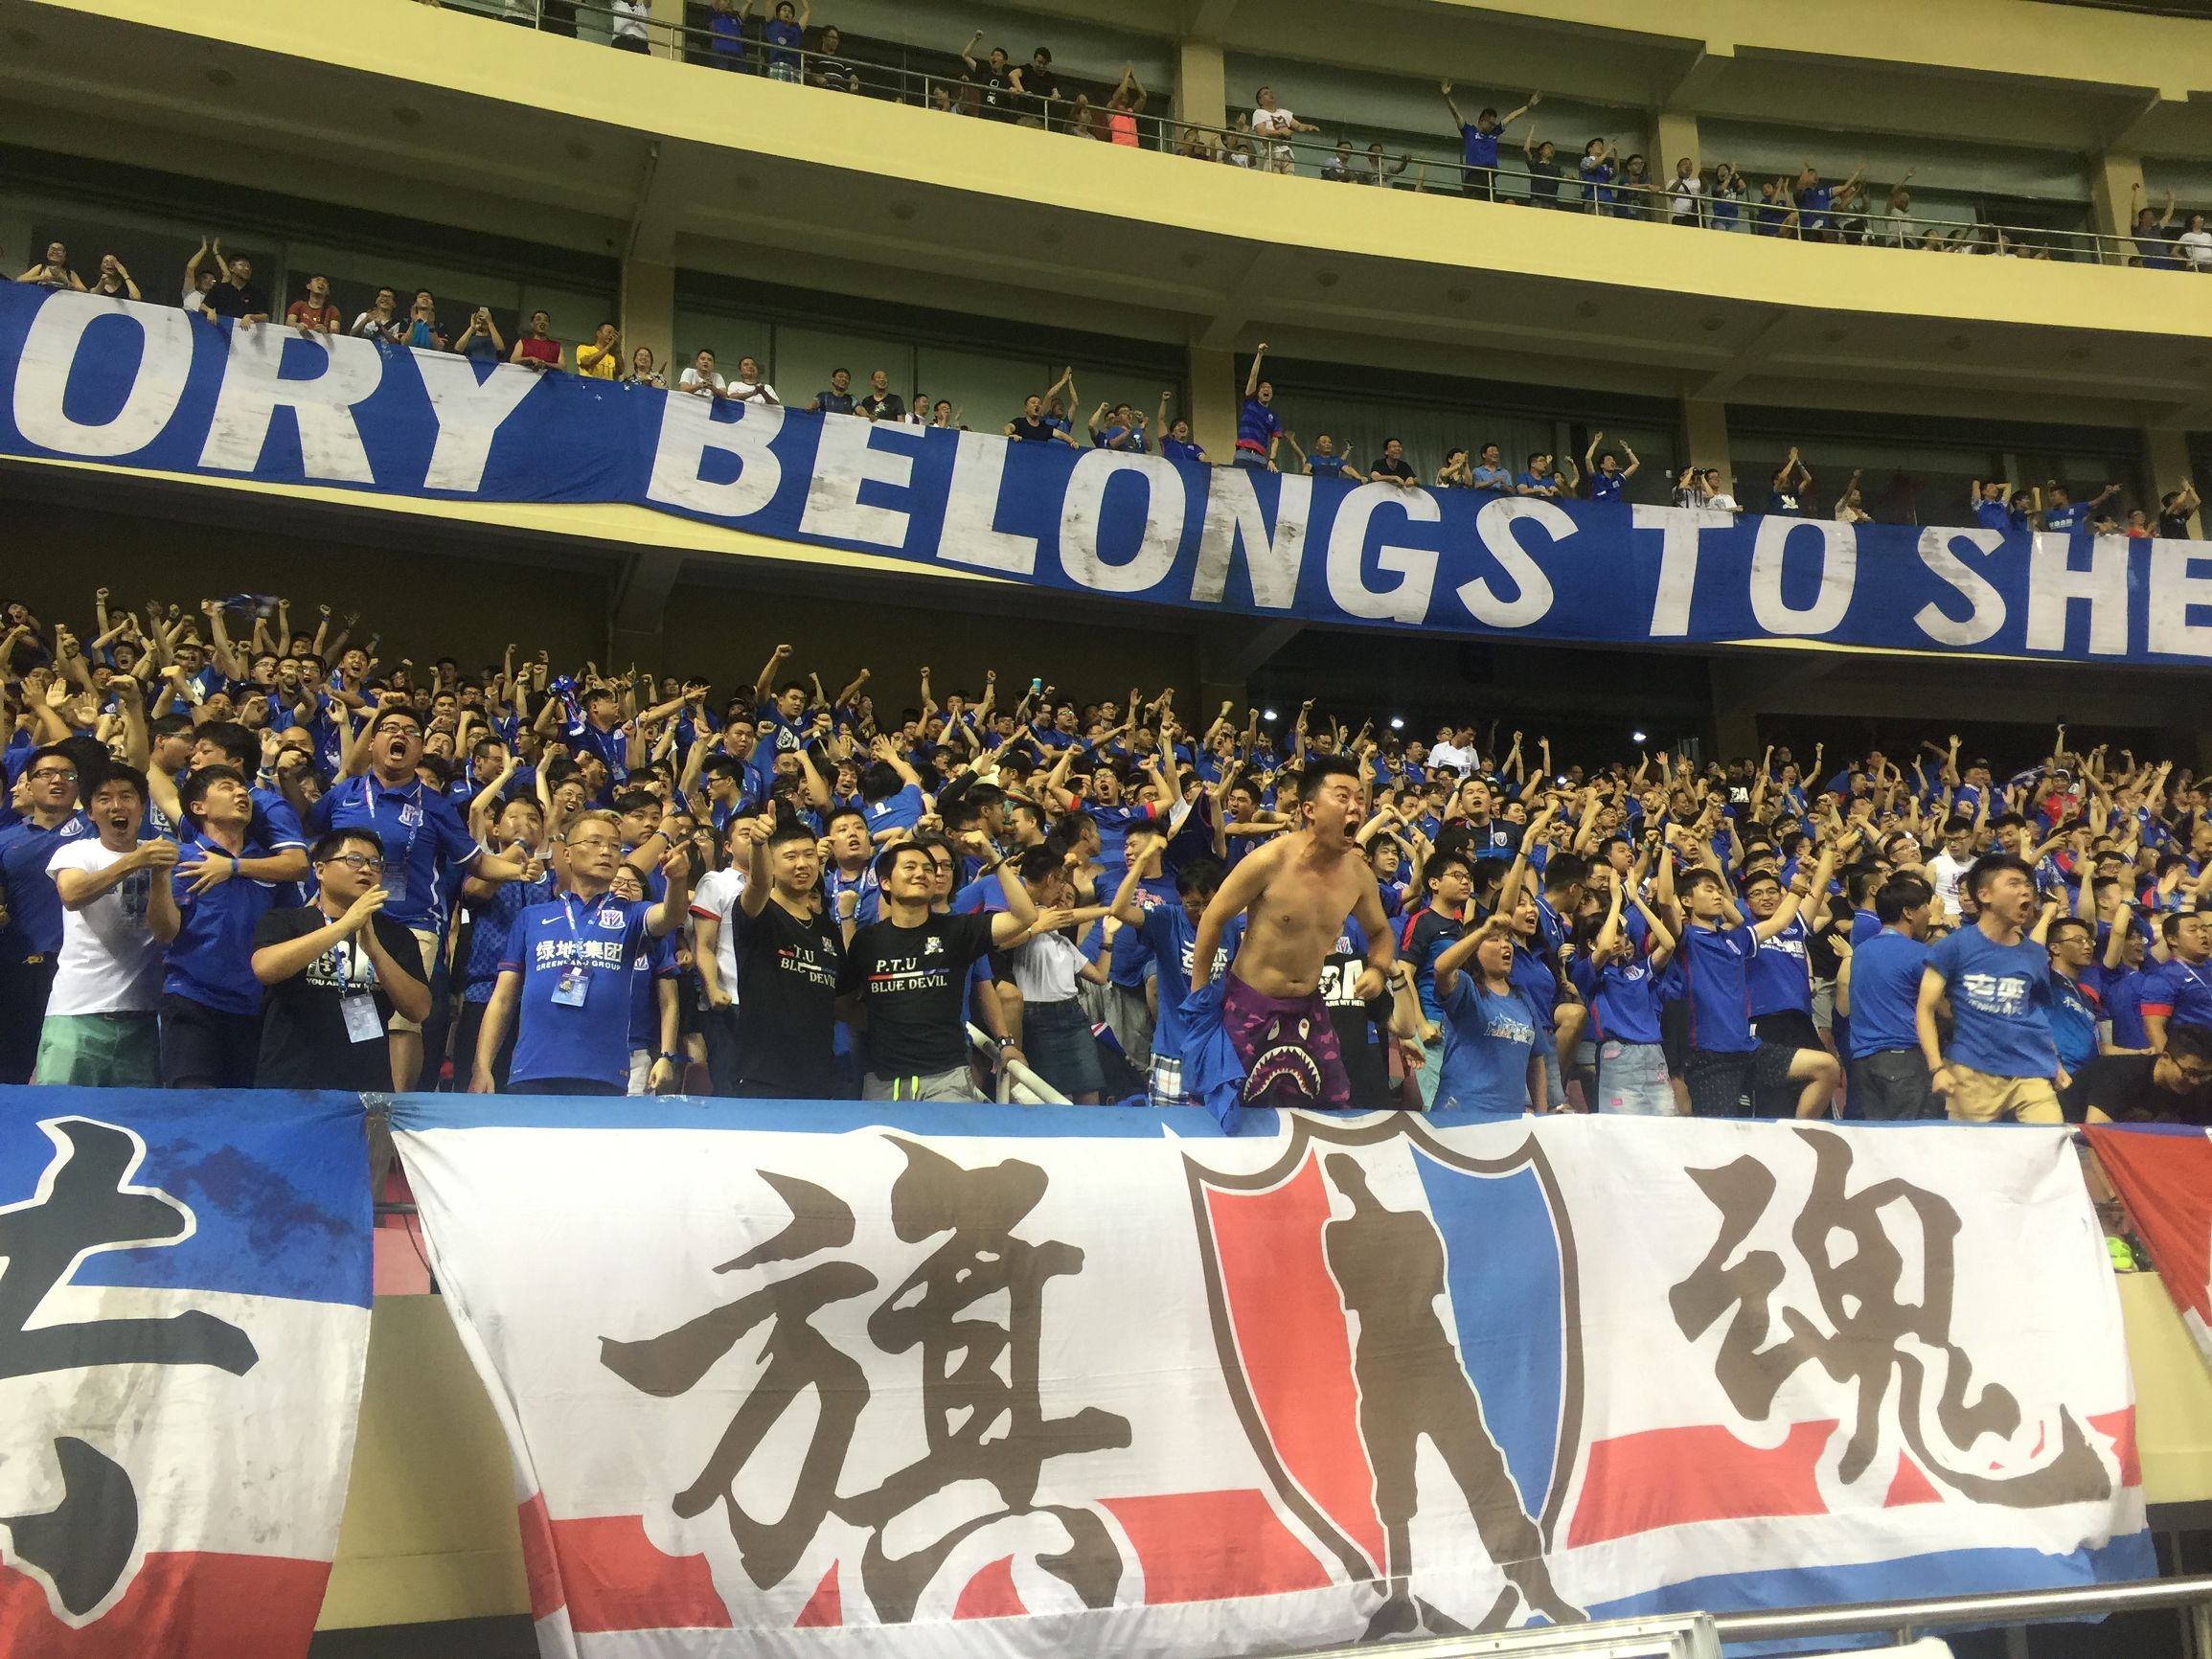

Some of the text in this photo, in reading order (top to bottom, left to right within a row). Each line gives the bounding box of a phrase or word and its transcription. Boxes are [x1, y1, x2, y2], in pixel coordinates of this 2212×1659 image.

[12, 289, 2212, 657] ORY BELONGS TO SHE
[536, 940, 623, 963] 绿地集团
[591, 960, 622, 971] GROUP
[306, 977, 325, 987] YOU
[810, 970, 836, 989] DEVIL
[871, 974, 948, 994] BLUE DEVIL
[1668, 1126, 2111, 1510] 魂
